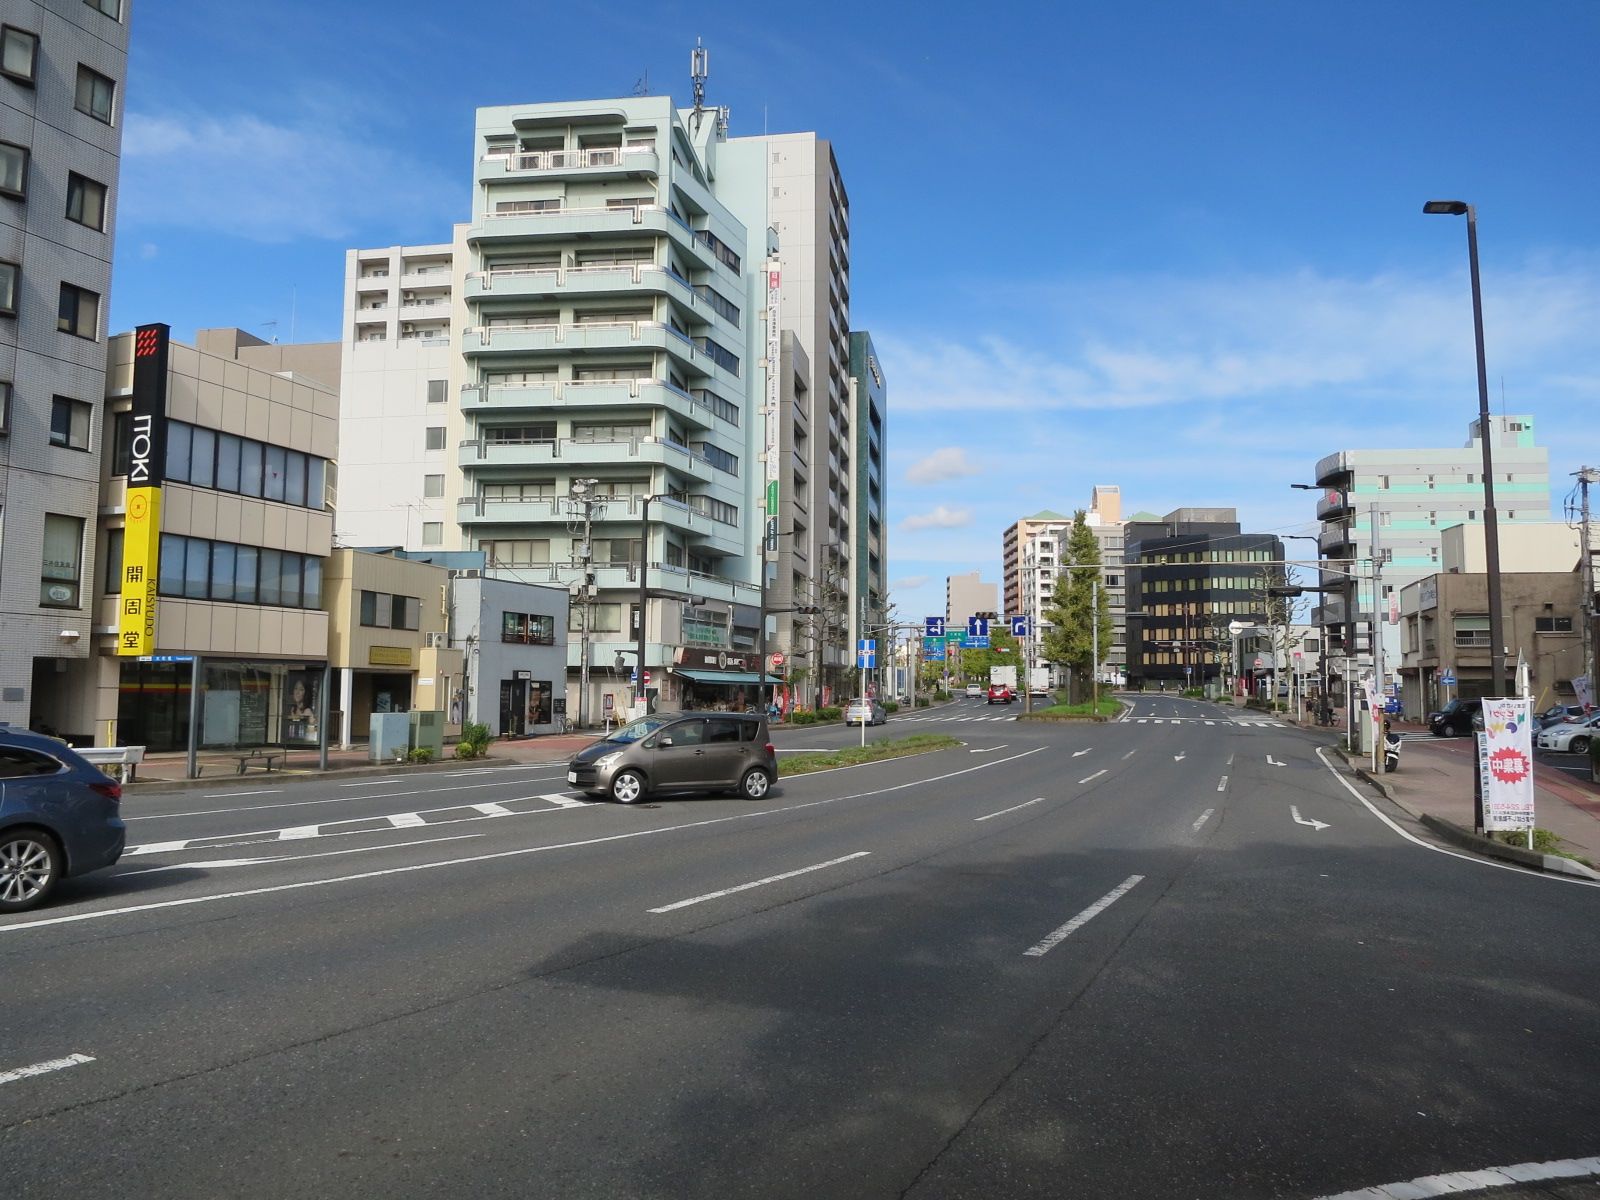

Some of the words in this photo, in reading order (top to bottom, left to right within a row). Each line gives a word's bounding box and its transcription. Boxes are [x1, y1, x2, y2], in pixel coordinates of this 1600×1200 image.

[131, 415, 152, 481] ITOKI
[123, 566, 143, 648] 開周堂
[145, 578, 156, 637] KAISYUDO
